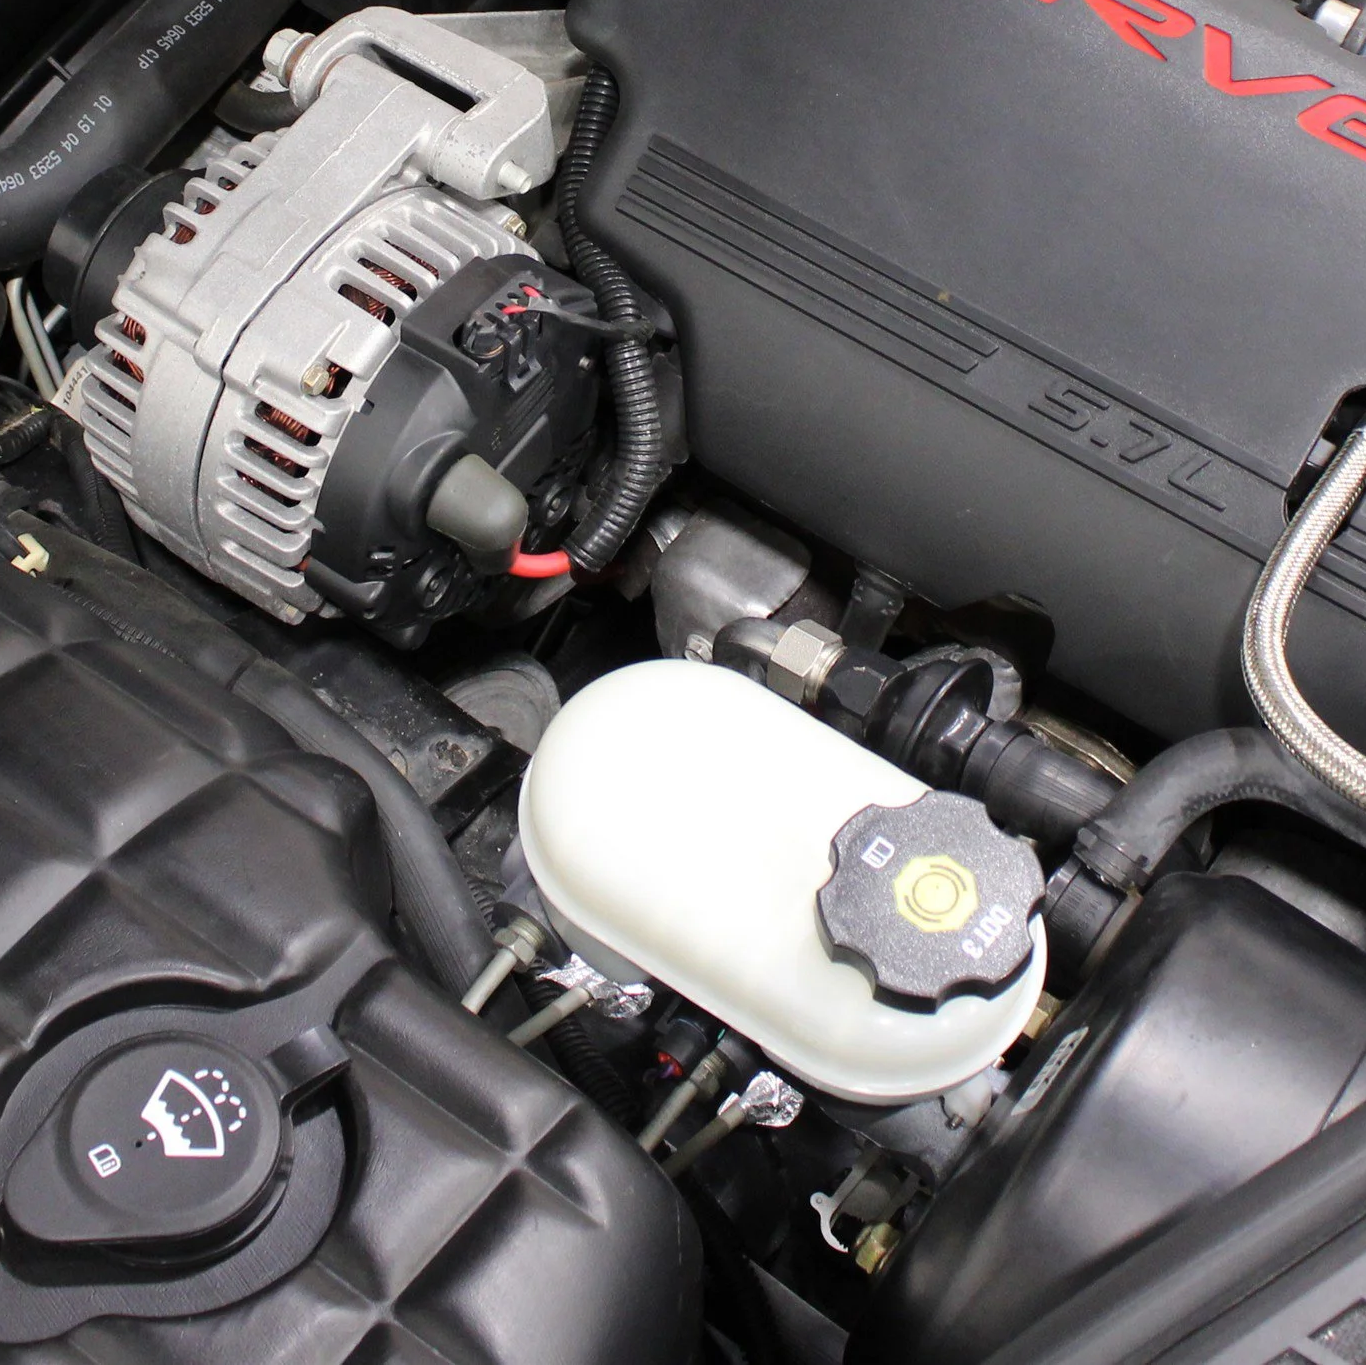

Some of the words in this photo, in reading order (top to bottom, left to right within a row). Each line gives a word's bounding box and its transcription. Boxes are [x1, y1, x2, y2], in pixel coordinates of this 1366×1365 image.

[184, 0, 215, 27] 5293
[156, 24, 186, 51] 0645
[93, 94, 113, 114] 01
[77, 113, 96, 134] 19
[60, 132, 80, 154] 04
[29, 150, 62, 180] 5293
[1026, 377, 1227, 512] 5.7L
[969, 902, 1014, 949] DOT
[958, 936, 985, 962] 3
